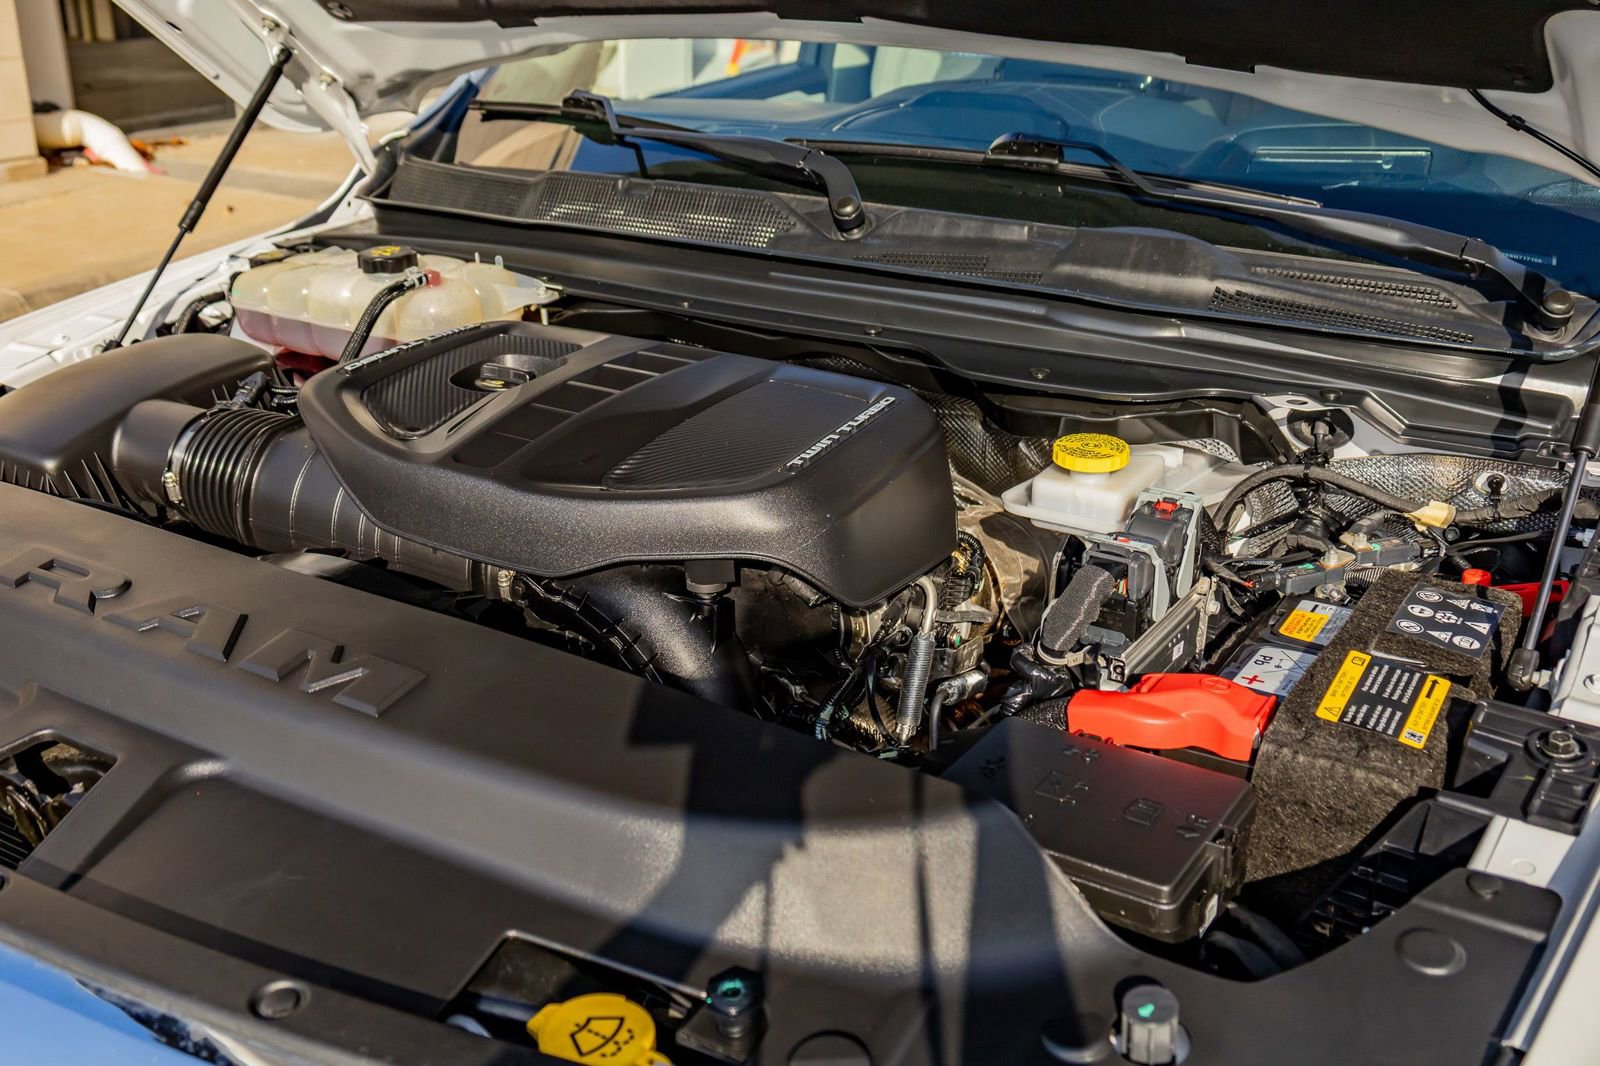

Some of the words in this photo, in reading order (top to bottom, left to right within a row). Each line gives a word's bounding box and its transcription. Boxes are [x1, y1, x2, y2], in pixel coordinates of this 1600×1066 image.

[786, 434, 841, 469] TWIN
[835, 396, 896, 434] TURBO
[0, 546, 428, 718] RAM
